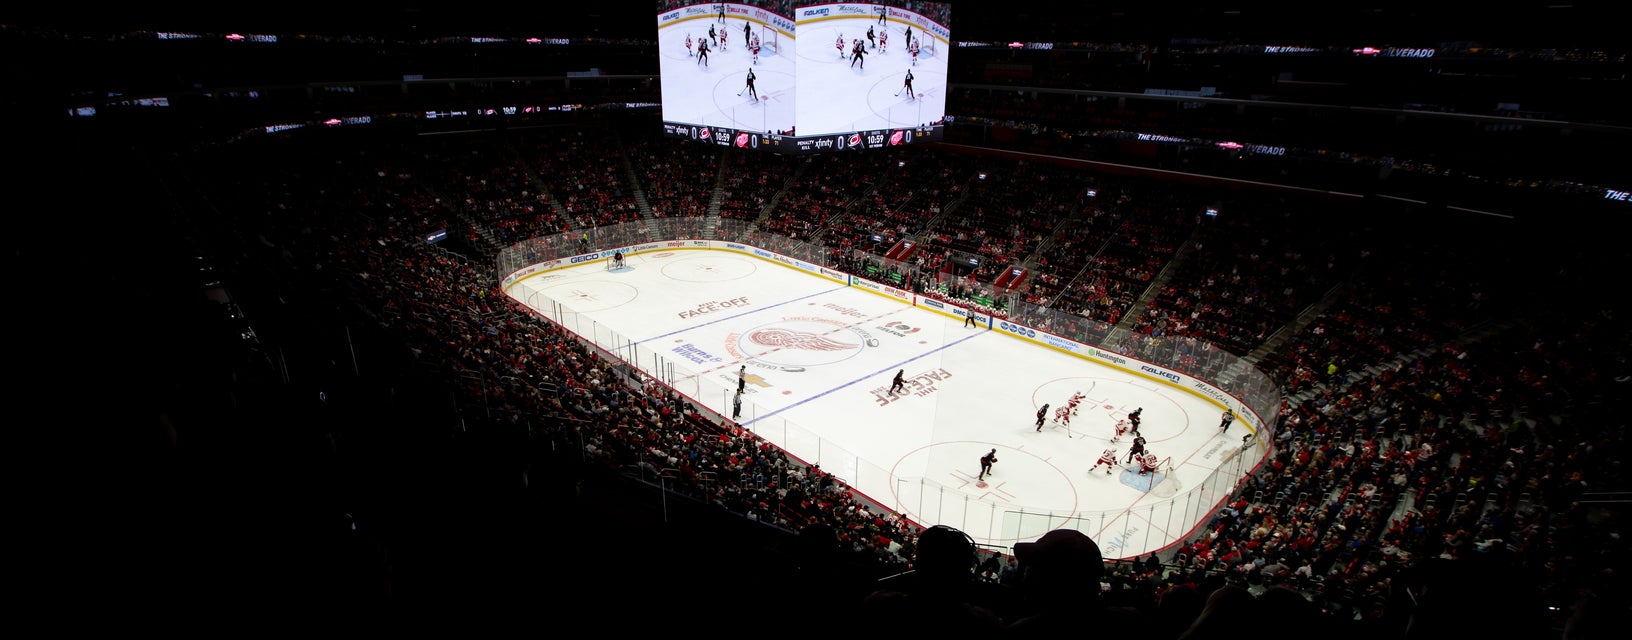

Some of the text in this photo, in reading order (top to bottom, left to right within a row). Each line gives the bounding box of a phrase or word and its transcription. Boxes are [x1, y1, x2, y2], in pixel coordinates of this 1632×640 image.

[804, 8, 829, 16] FALKEN
[676, 126, 689, 136] xfinity
[692, 127, 697, 140] 0
[715, 132, 730, 141] 10:59
[906, 130, 911, 143] 0
[1137, 133, 1150, 141] THE
[751, 134, 757, 148] 0
[815, 139, 833, 149] xfinity
[838, 136, 844, 150] 0
[868, 135, 884, 144] 10:59
[1604, 189, 1629, 201] THE
[570, 254, 599, 264] GEICO
[1044, 334, 1079, 348] INTERNATIONAL
[672, 346, 707, 365] Wilcox
[681, 344, 712, 359] Burns
[1095, 350, 1126, 365] Huntington
[1141, 365, 1180, 381] FALKEN
[914, 386, 938, 397] NHL
